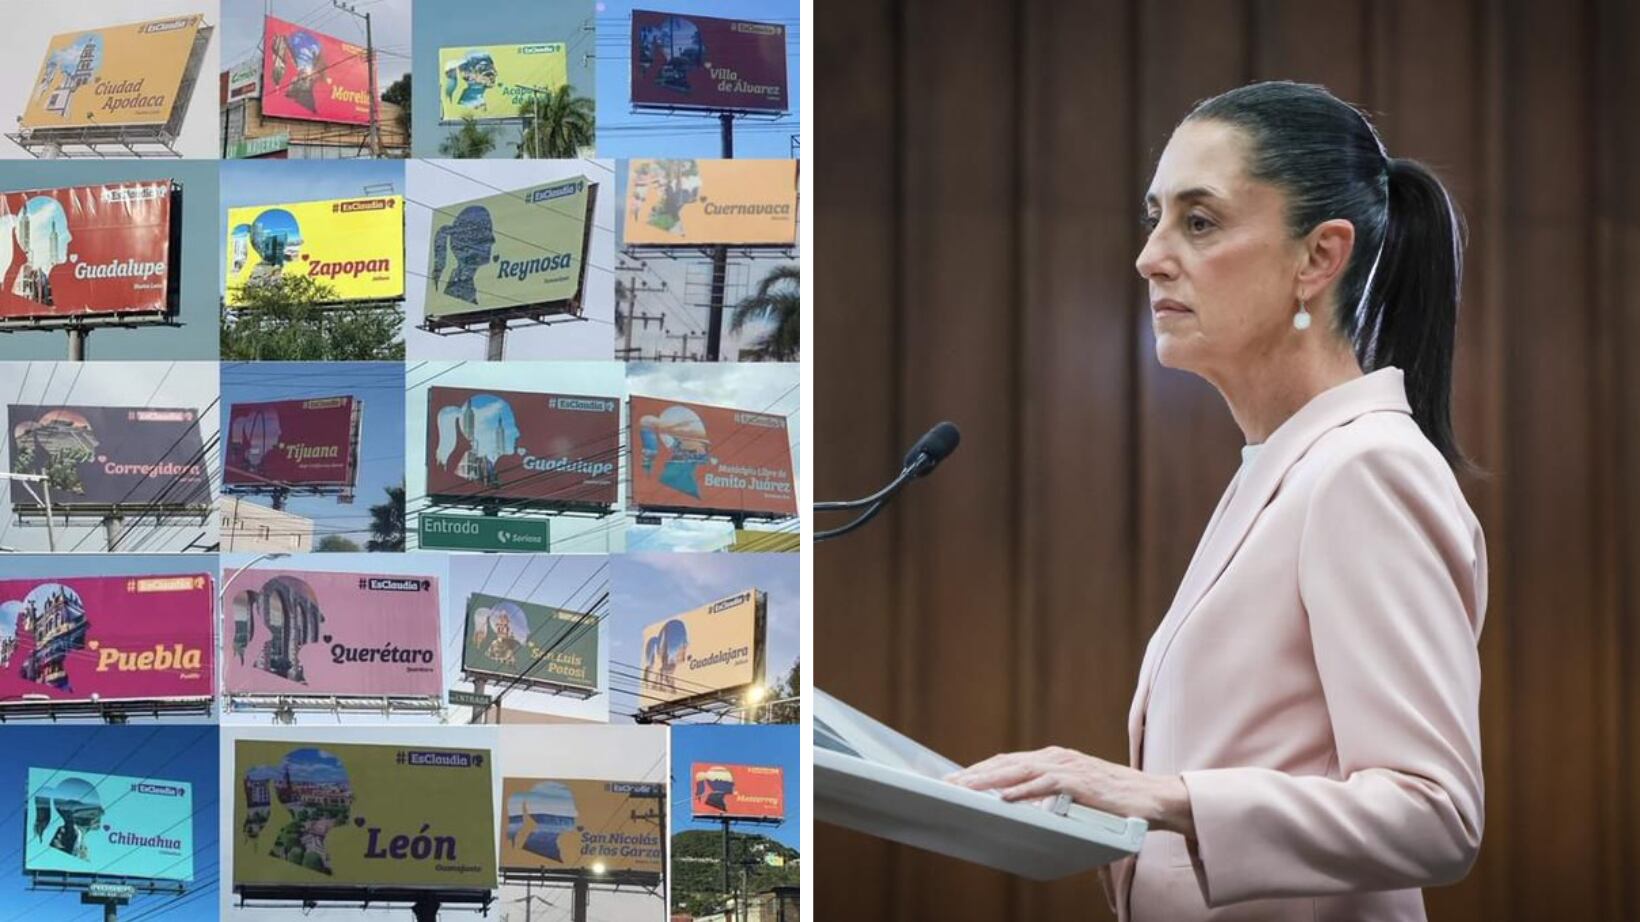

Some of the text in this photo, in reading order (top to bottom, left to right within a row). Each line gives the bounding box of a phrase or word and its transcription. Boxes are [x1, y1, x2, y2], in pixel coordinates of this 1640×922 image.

[710, 68, 738, 80] Villa
[95, 78, 144, 95] Ciudad
[331, 85, 369, 105] Moreli
[718, 80, 780, 96] de Álvarez
[102, 94, 165, 112] Apodaca
[703, 202, 790, 216] Cuernavaca
[75, 259, 165, 281] Guadalupe
[308, 259, 390, 279] Zapopan
[497, 253, 572, 281] Reynosa
[283, 442, 338, 462] Tijuana
[523, 456, 614, 477] Guadalupe
[704, 473, 792, 493] Benito Juárez
[424, 518, 479, 534] Entrada
[96, 643, 202, 671] Puebla
[331, 642, 434, 664] Querétaro
[556, 652, 583, 665] Luis
[689, 646, 749, 670] Guadalajara
[396, 750, 470, 767] #EsClaudia
[108, 831, 182, 849] Chihuahua
[364, 823, 457, 861] León
[581, 831, 659, 845] San Nicolás
[581, 842, 596, 856] de
